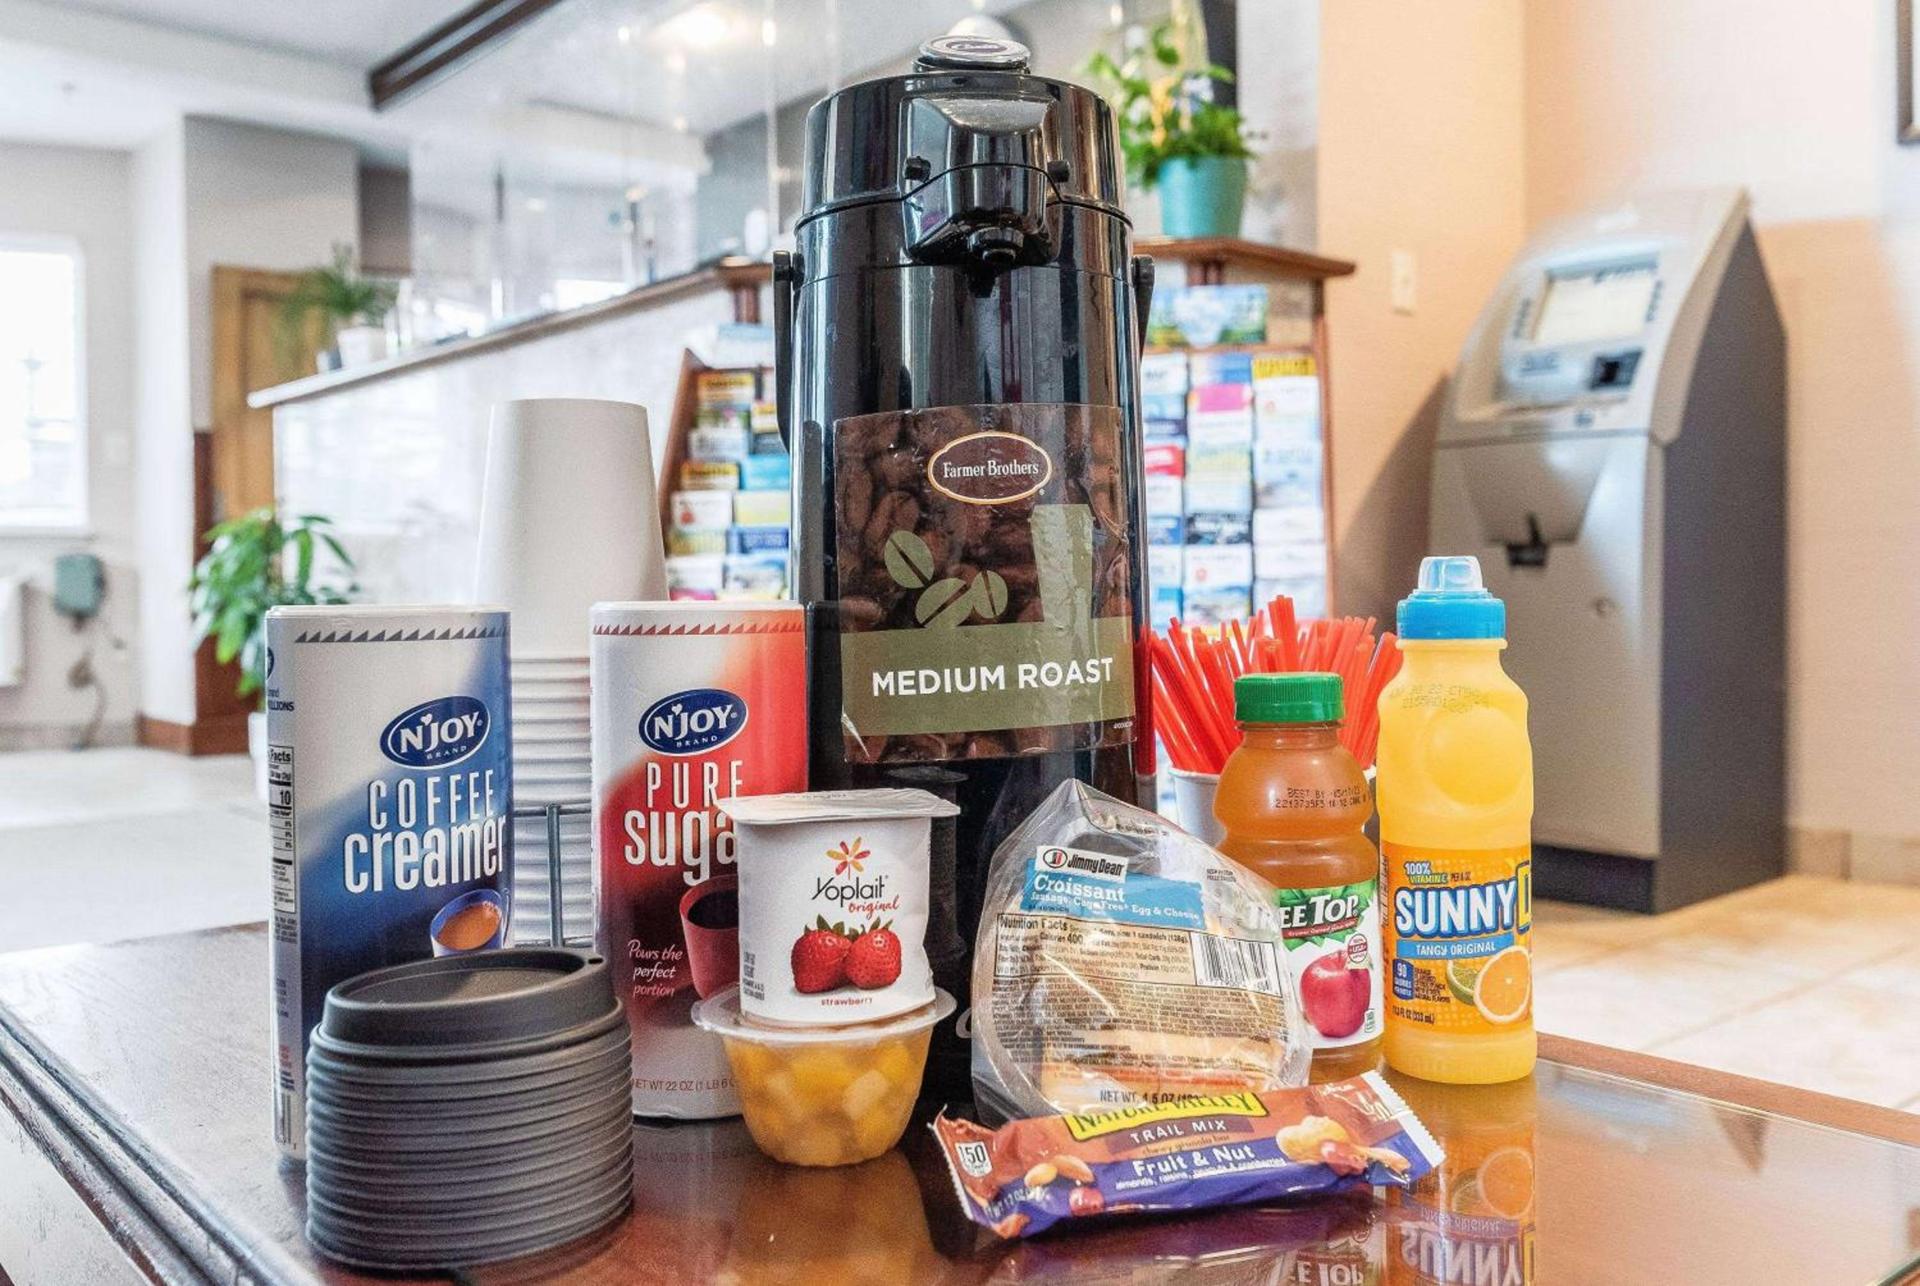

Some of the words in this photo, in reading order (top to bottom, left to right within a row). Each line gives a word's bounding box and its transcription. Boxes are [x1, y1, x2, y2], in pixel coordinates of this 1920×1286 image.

[943, 462, 985, 478] Farmer
[988, 460, 1039, 476] Brothers
[872, 665, 1006, 697] MEDIUM
[1018, 657, 1114, 689] ROAST
[676, 735, 718, 748] BRAND
[427, 745, 467, 760] BRAND
[647, 760, 744, 808] PURE
[1287, 787, 1310, 798] BEST
[280, 790, 292, 805] 10
[369, 768, 494, 830] COFFEE
[344, 816, 507, 893] creamer
[624, 810, 738, 887] suga
[1068, 854, 1098, 873] Jimmy
[1098, 859, 1122, 876] Dean
[1405, 862, 1431, 875] 100%
[1034, 873, 1125, 902] Croissant
[1410, 874, 1441, 884] VITAMIN
[811, 875, 886, 908] Yoplait
[1131, 904, 1151, 916] Egg
[1153, 906, 1162, 916] &
[1280, 905, 1308, 929] EE
[1395, 879, 1517, 936] SUNNY
[627, 939, 659, 960] Pours
[661, 944, 683, 960] the
[1416, 944, 1448, 956] TANGY
[1450, 943, 1497, 955] ORIGINAL
[633, 962, 677, 982] perfect
[632, 983, 675, 997] portion
[649, 1080, 665, 1090] WT
[665, 1081, 678, 1091] 22
[680, 1081, 694, 1091] OZ
[707, 1080, 719, 1090] LB
[1100, 1090, 1119, 1103] NET
[1130, 1124, 1184, 1144] TRAIL
[1191, 1119, 1227, 1132] MIX
[959, 1145, 986, 1164] 150
[1132, 1155, 1188, 1177] Fruit
[1192, 1151, 1209, 1167] &
[1212, 1145, 1256, 1162] Nut
